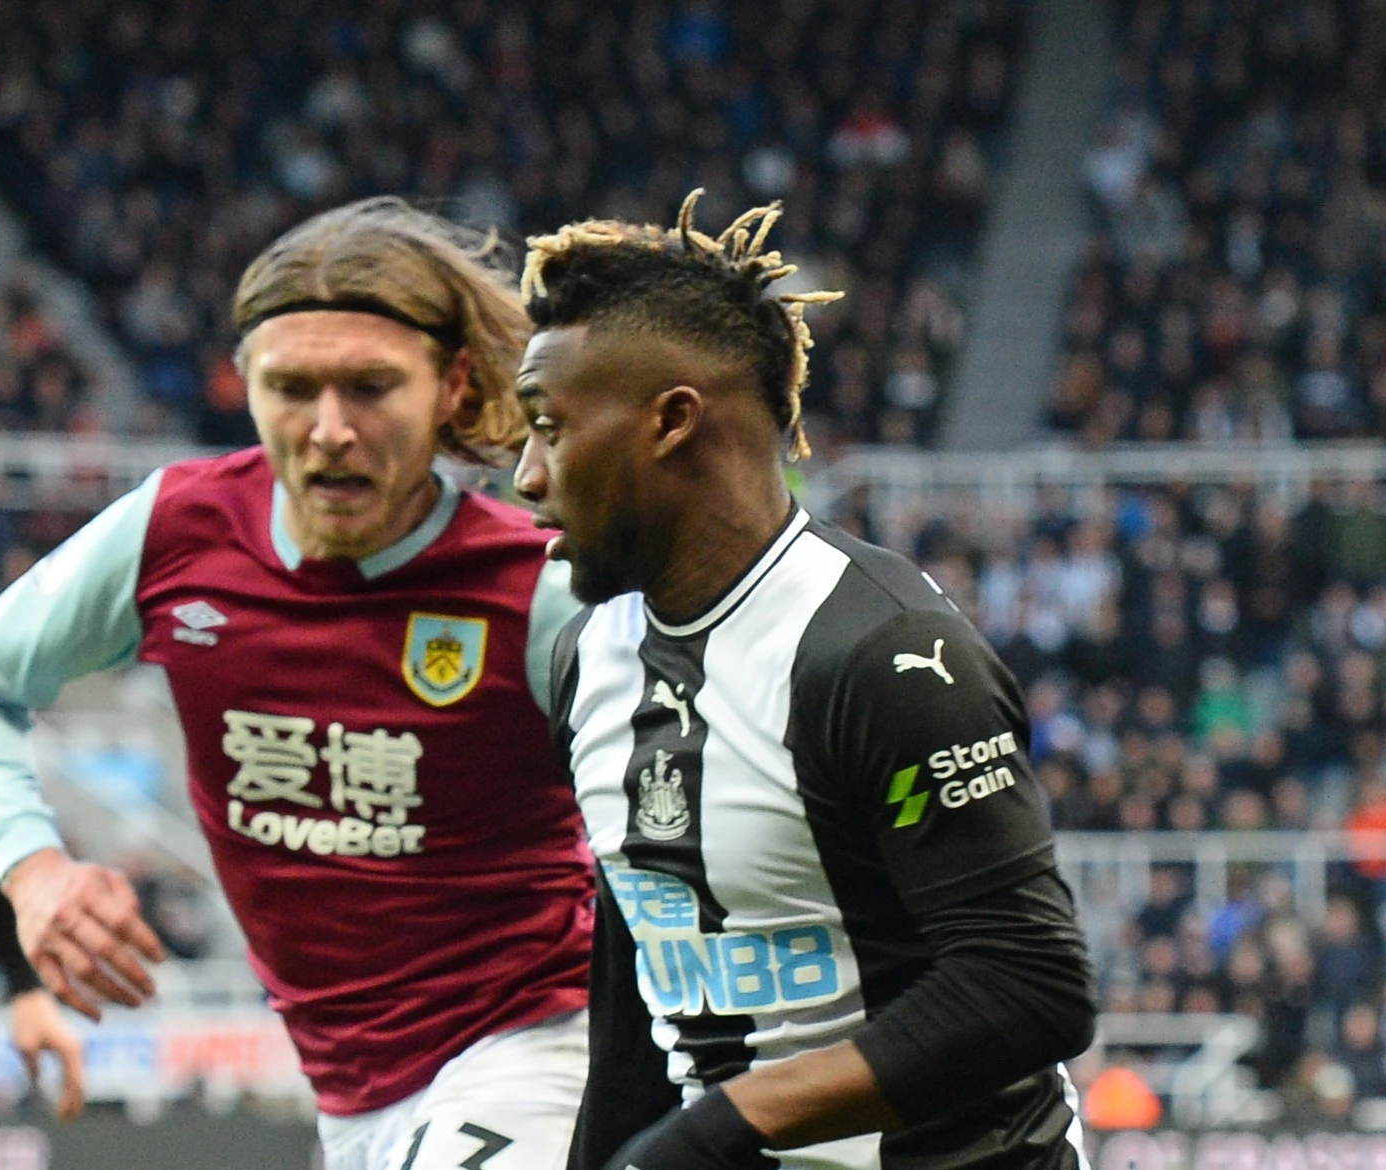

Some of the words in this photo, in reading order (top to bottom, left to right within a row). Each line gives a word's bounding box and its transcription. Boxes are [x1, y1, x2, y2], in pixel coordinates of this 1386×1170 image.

[222, 709, 424, 827] 爱博
[928, 731, 1018, 779] Storm
[939, 765, 1016, 809] Gain
[228, 800, 427, 857] LoveBet
[637, 925, 838, 1010] UN88
